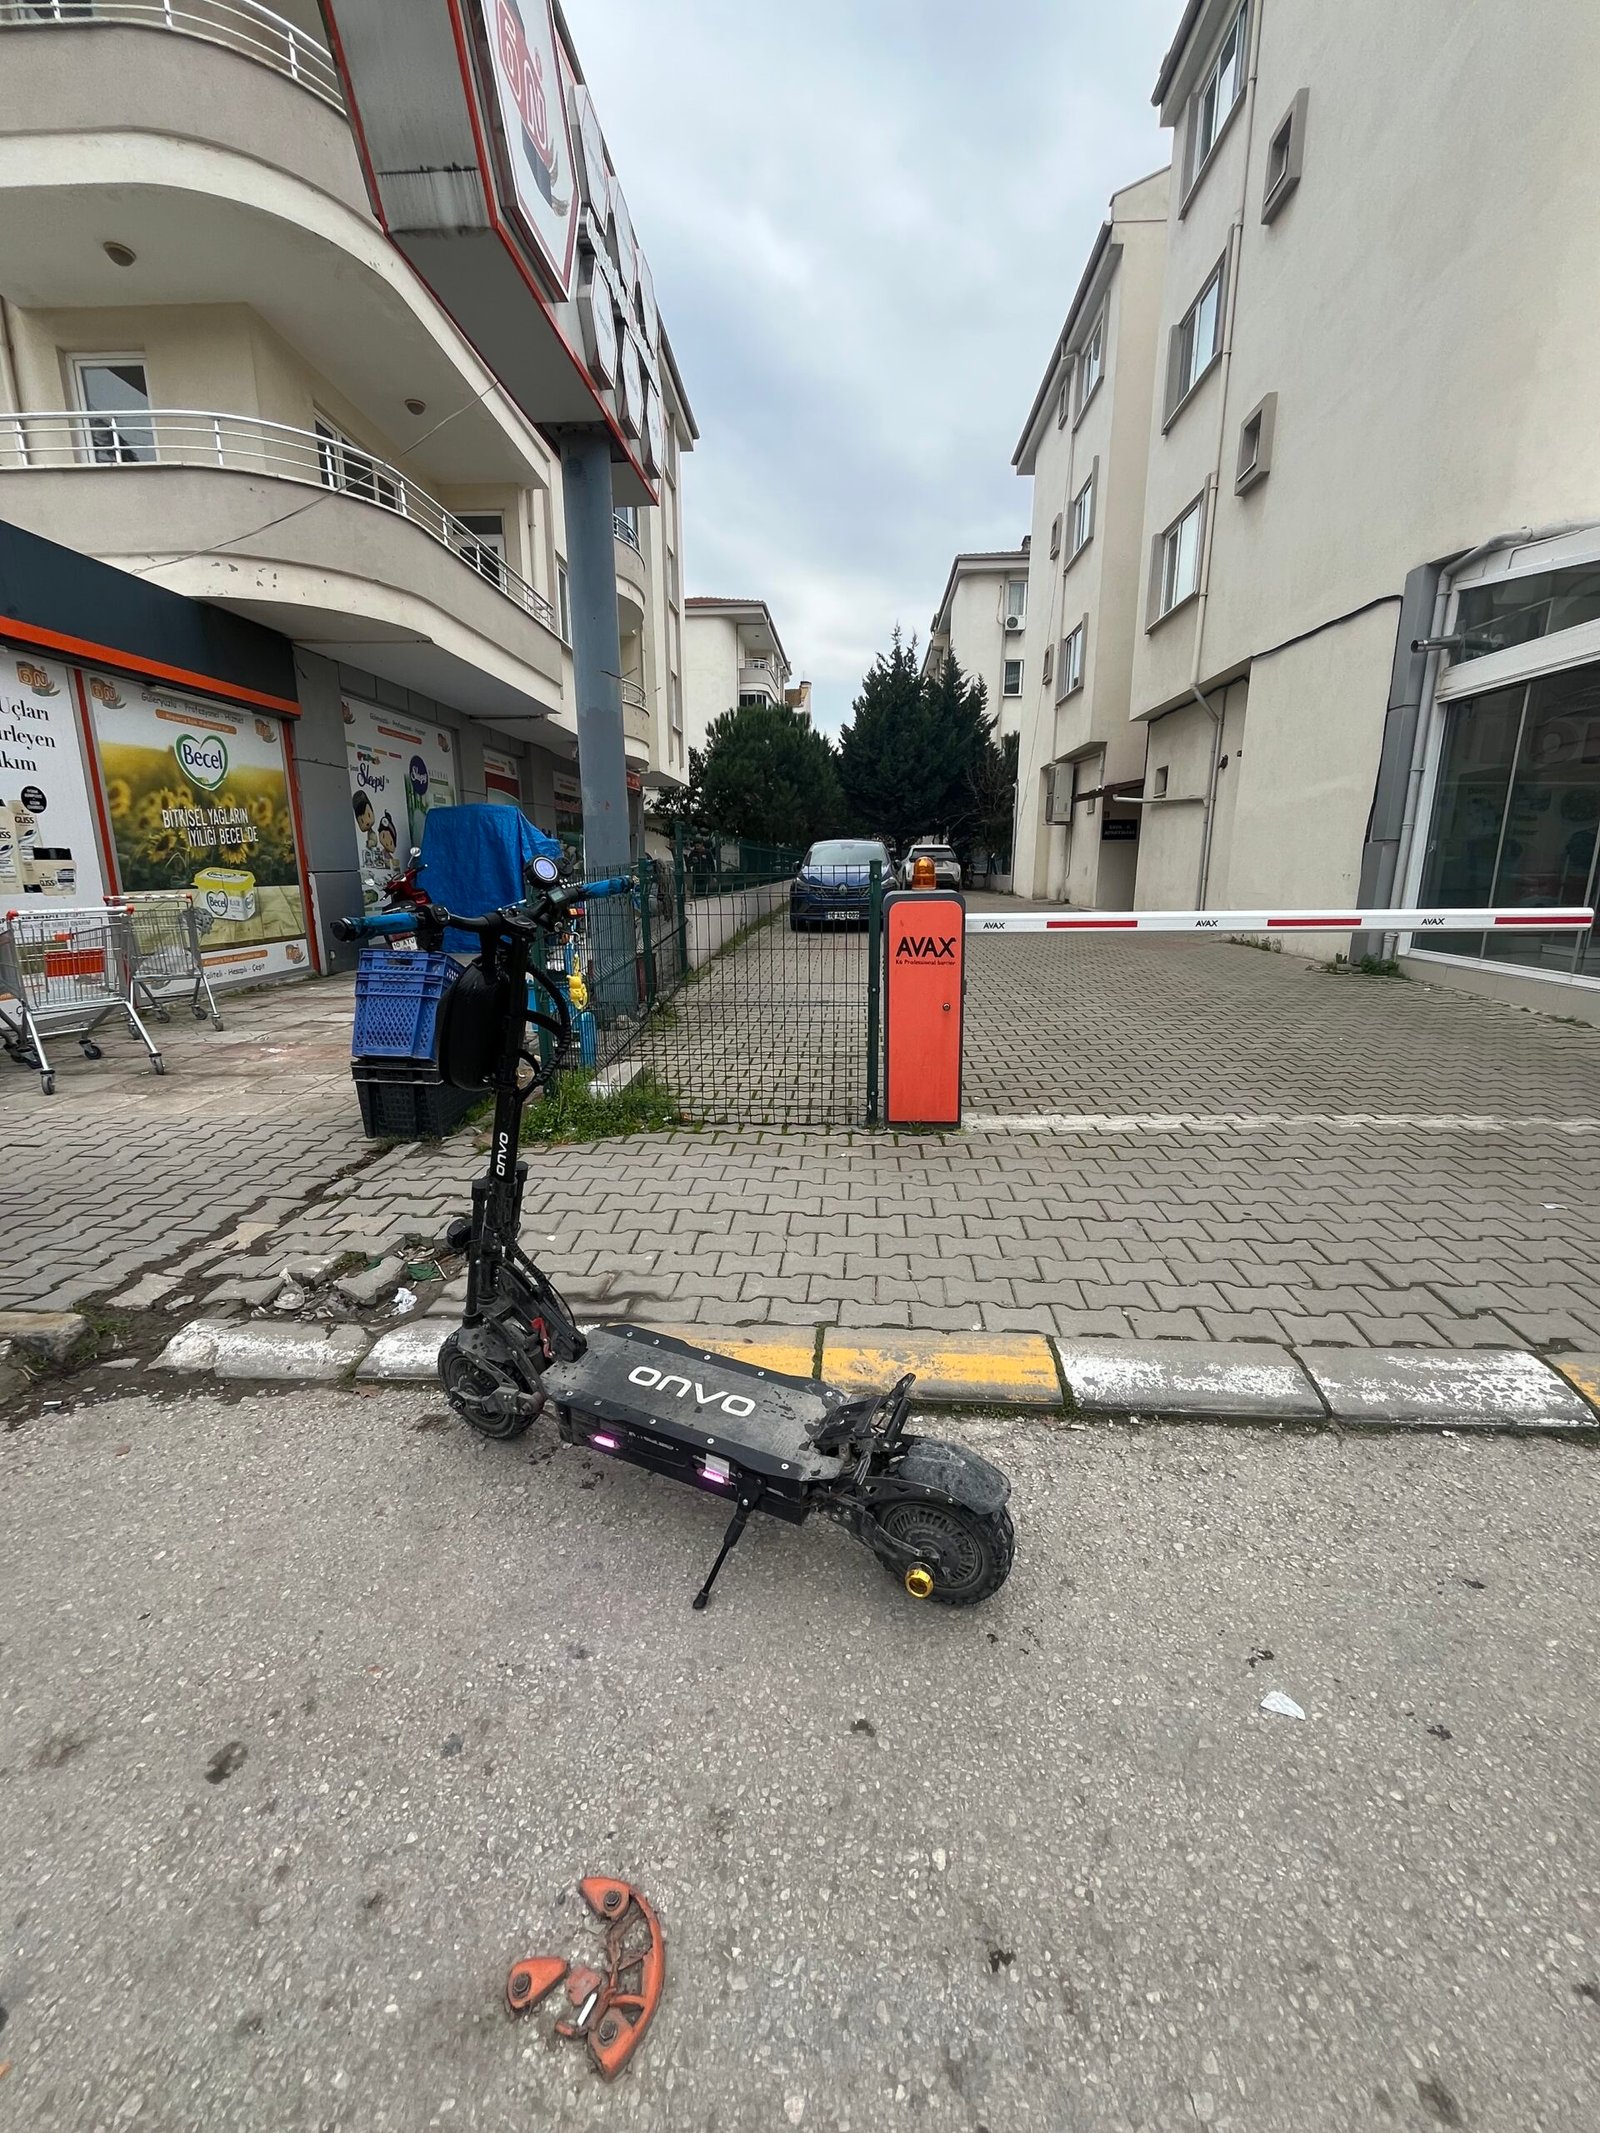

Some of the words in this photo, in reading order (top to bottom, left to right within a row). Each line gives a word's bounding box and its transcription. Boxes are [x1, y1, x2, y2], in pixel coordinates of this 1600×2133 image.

[0, 725, 56, 750] rleyen
[0, 751, 37, 771] kım
[182, 744, 223, 769] Becel
[357, 763, 385, 793] Sleepy
[162, 806, 208, 828] BİTKİSEL
[207, 806, 249, 825] YAĞLARIN
[983, 922, 1006, 930] AVAX
[1195, 920, 1218, 928] AVAX
[1421, 918, 1445, 926] AVAX
[896, 936, 957, 958] AVAX
